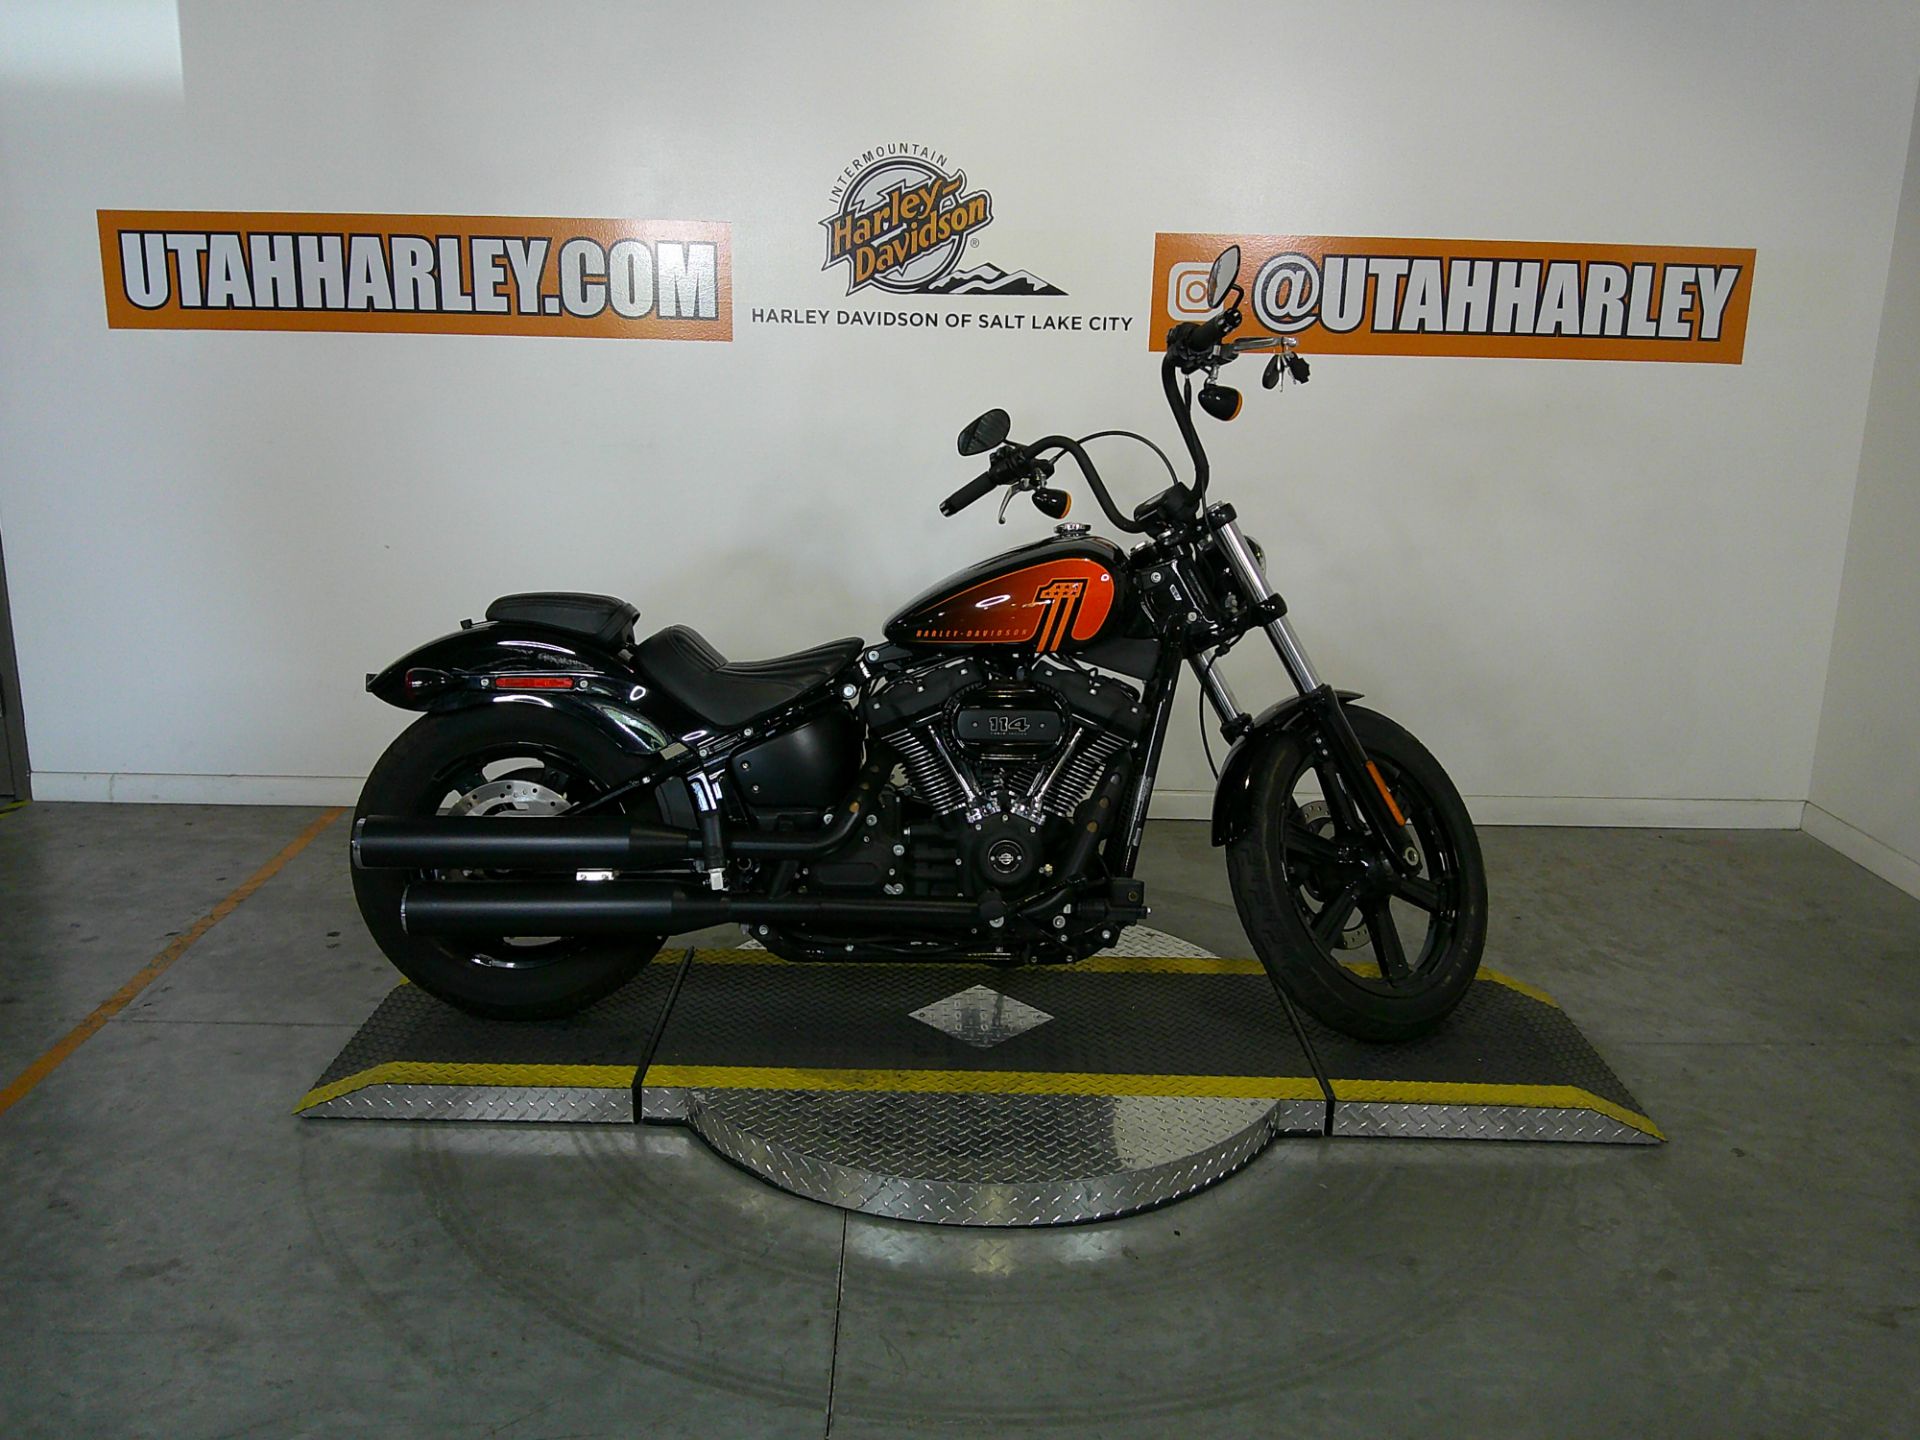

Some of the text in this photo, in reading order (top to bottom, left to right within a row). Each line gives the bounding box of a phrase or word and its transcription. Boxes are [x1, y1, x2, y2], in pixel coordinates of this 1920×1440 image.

[829, 142, 948, 204] INTERMOUNTAIN
[831, 177, 962, 258] Harley-
[853, 195, 988, 286] Davidson
[117, 229, 719, 320] UTAHHARLEY.COM
[1252, 251, 1742, 342] @UTAHHARLEY
[752, 308, 1133, 332] HARLEY DAVIDSON OF SALT LAKE CITY
[988, 716, 1031, 732] 114
